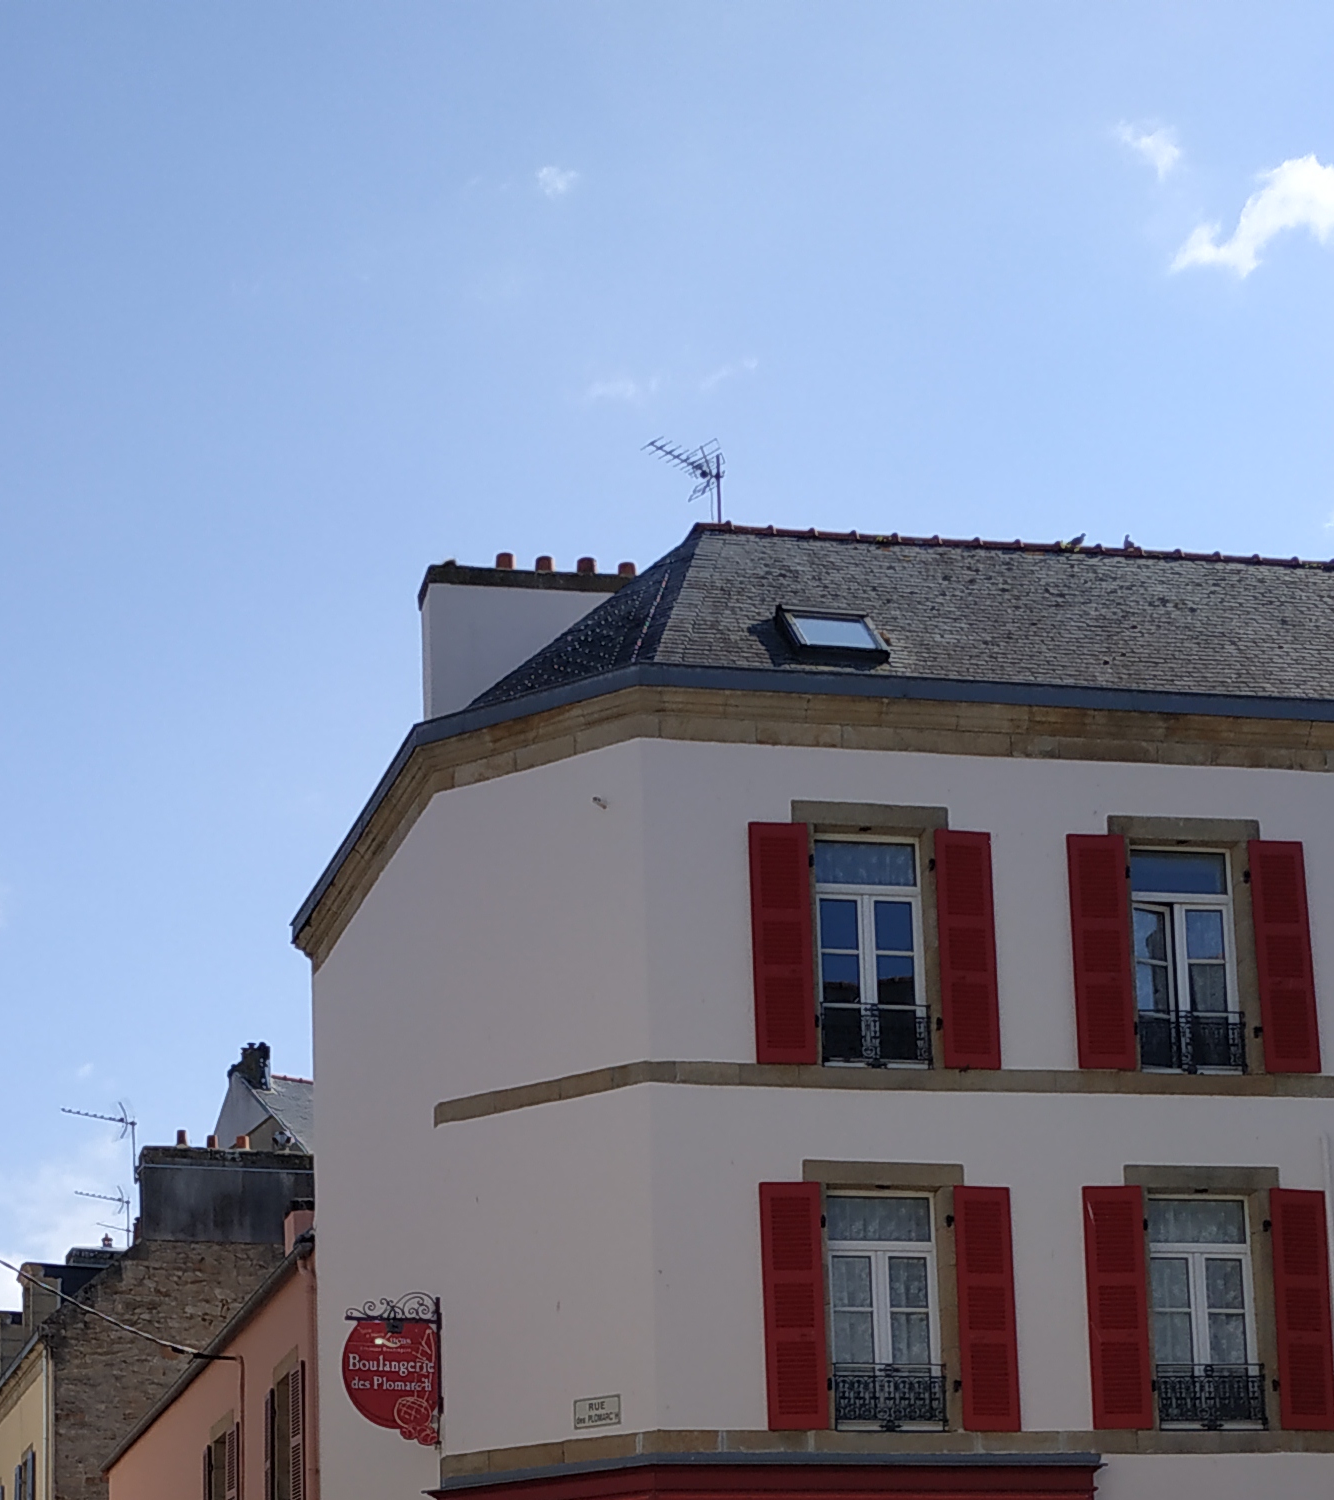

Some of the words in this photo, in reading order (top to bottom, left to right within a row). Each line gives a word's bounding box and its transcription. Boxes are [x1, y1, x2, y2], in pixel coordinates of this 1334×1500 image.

[348, 1353, 435, 1376] Boulangerie
[351, 1376, 370, 1389] des
[588, 1401, 606, 1411] RUE
